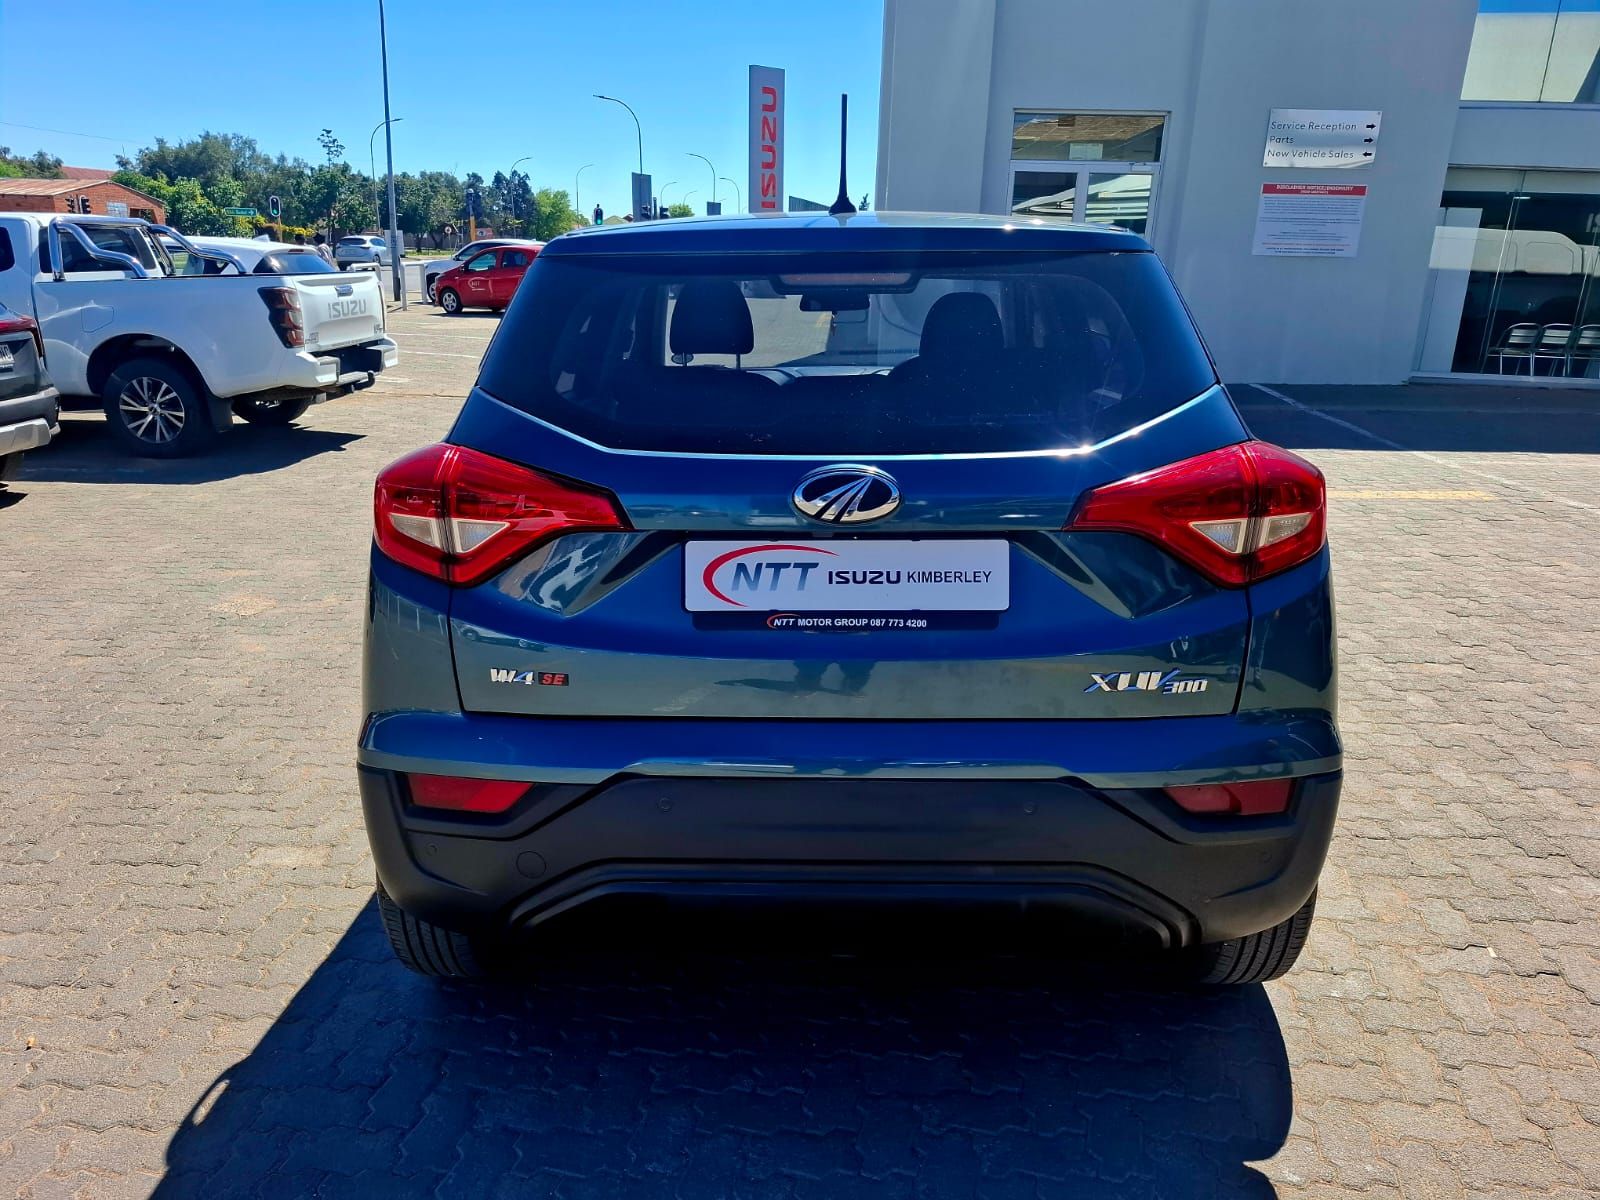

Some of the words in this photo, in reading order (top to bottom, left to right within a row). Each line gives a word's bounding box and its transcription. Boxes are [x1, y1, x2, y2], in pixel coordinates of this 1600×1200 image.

[1271, 121, 1306, 130] Service
[1308, 121, 1357, 132] Reception
[1269, 135, 1294, 144] Parts
[761, 86, 777, 209] ISUZU
[1267, 149, 1290, 158] New
[1292, 149, 1326, 158] Vehicle
[1328, 150, 1354, 159] Sales
[328, 299, 367, 319] ISUZU
[731, 562, 820, 592] NTT
[828, 570, 902, 585] ISUZU
[907, 571, 992, 583] KIMBERLEY
[773, 618, 796, 626] NTT
[797, 618, 832, 626] MOTOR
[834, 618, 869, 627] GROUP
[870, 618, 886, 627] 087
[888, 619, 904, 627] 773
[906, 619, 927, 628] 4200
[490, 668, 535, 685] W4
[542, 673, 564, 685] SE
